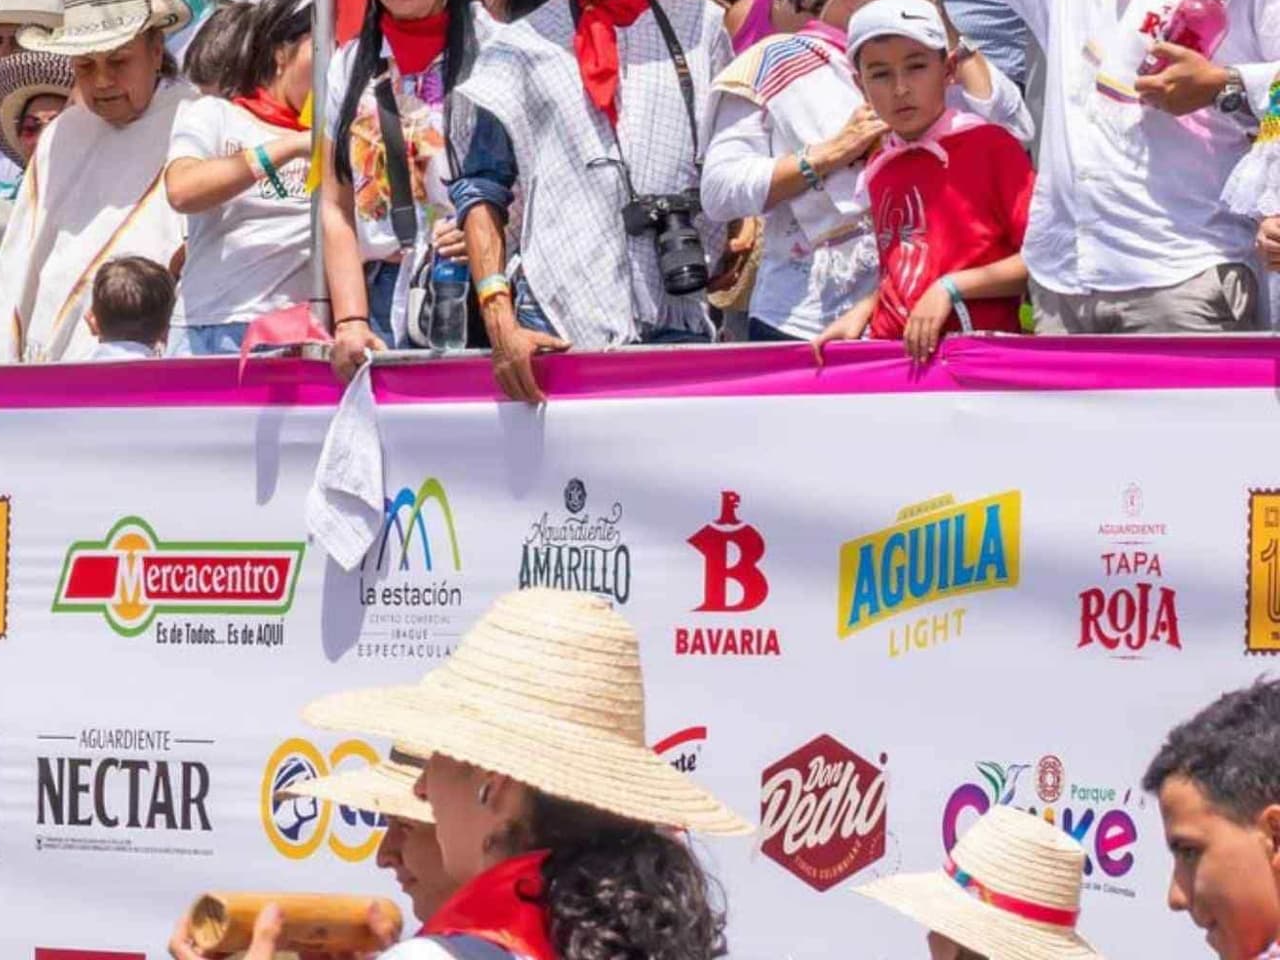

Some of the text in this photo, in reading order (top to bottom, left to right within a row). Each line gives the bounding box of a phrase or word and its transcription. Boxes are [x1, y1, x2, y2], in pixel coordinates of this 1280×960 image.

[1098, 524, 1167, 535] AGUARDIENTE
[120, 553, 279, 601] Mercacentro
[519, 544, 630, 604] AMARILLO
[848, 503, 1009, 628] AGUILA
[1101, 551, 1162, 576] TAPA
[360, 577, 462, 606] la estación
[1077, 582, 1182, 651] ROJA
[156, 622, 167, 644] Es
[170, 622, 182, 644] de
[228, 623, 239, 645] Es
[241, 624, 254, 645] de
[676, 628, 780, 655] BAVARIA
[889, 609, 966, 658] LIGHT
[358, 644, 458, 658] ESPECTACULA
[80, 729, 171, 751] AGUARDIENTE
[803, 755, 843, 791] Don
[37, 756, 213, 831] NECTAR
[761, 761, 887, 855] Pedro
[1071, 785, 1116, 804] Parque
